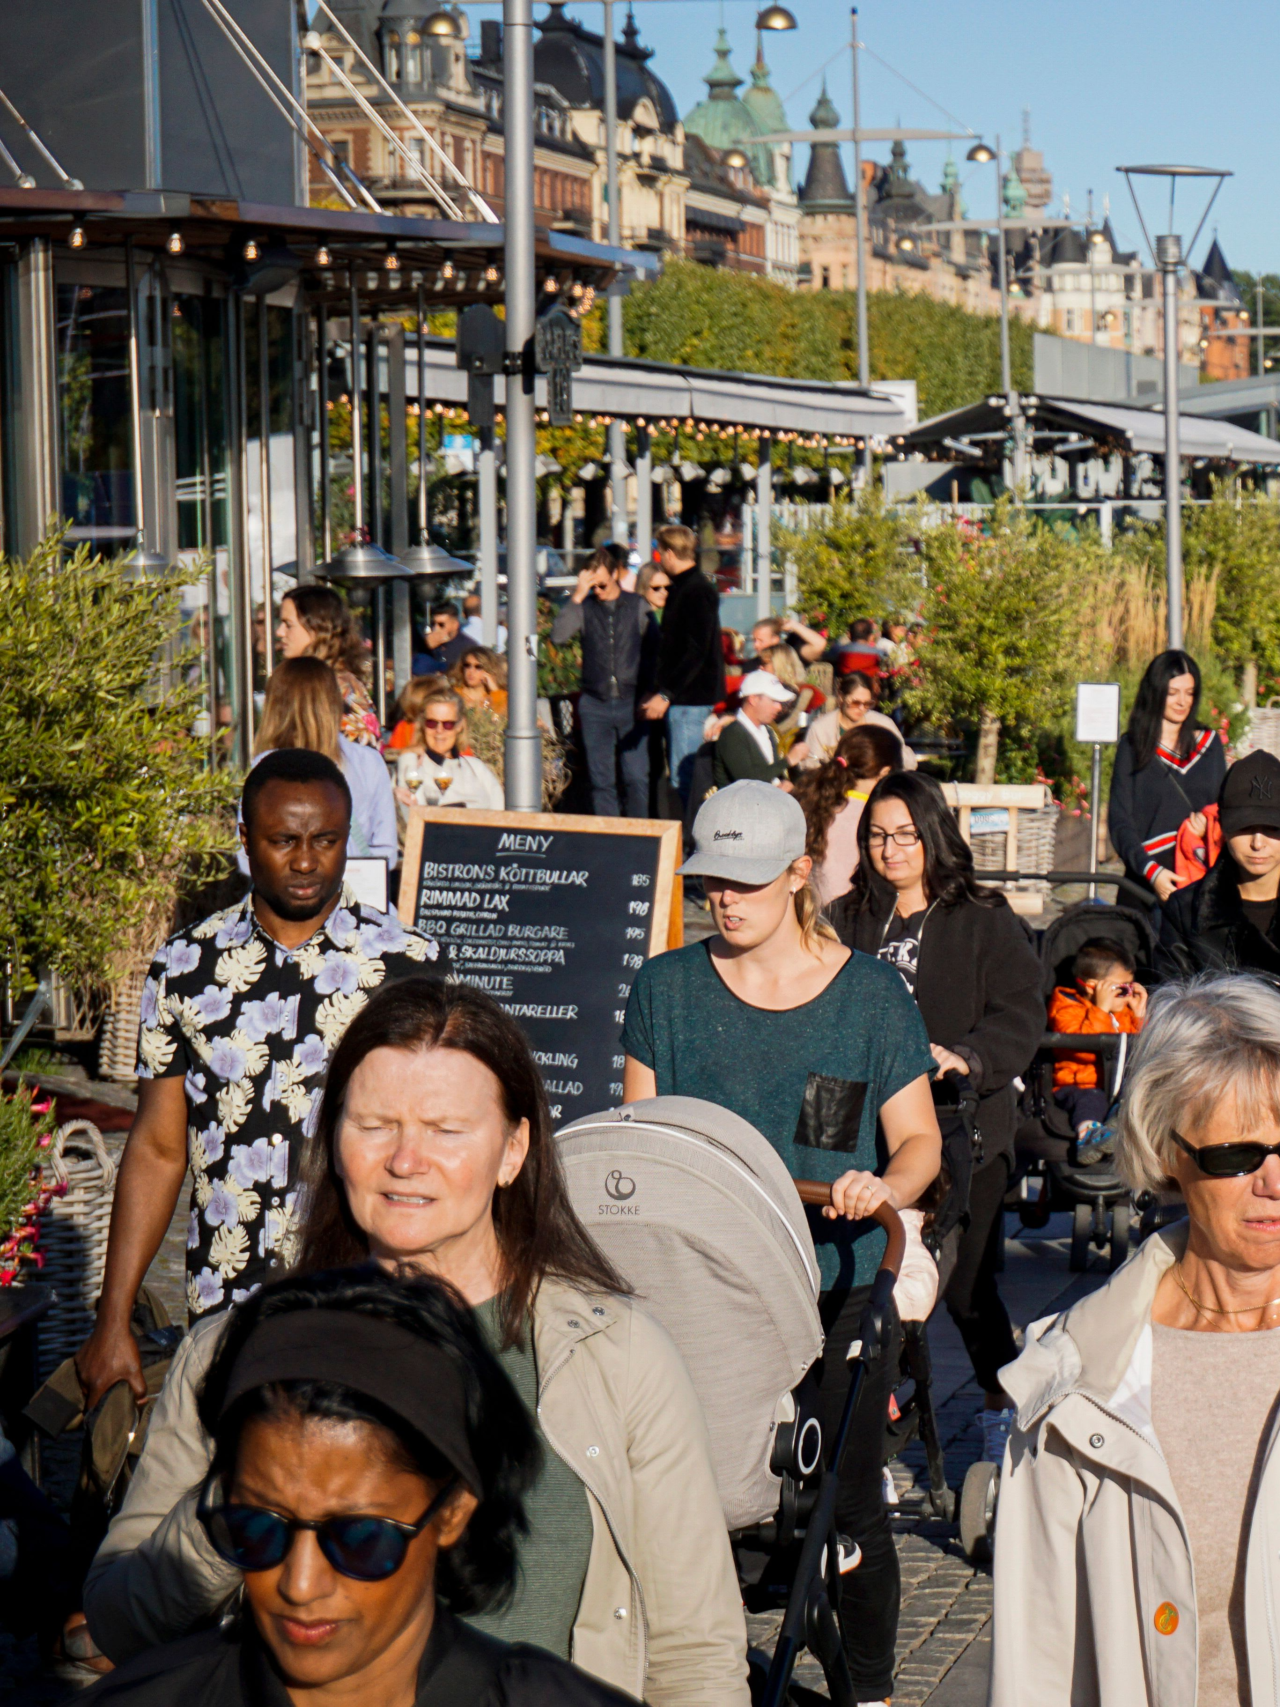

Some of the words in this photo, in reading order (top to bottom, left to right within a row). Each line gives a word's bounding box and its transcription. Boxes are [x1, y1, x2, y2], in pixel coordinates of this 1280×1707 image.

[497, 832, 554, 852] MENY
[713, 829, 743, 842] Brooklyn
[423, 861, 496, 880] BISTRONS
[499, 863, 589, 887] KÖTTBULLAR
[631, 873, 651, 887] 185
[420, 888, 481, 908] RIMMAD
[483, 893, 510, 912] LAX
[628, 900, 650, 916] 198
[418, 918, 447, 935] BBQ
[450, 922, 505, 938] GRILLAD
[508, 923, 569, 939] BURGARE
[625, 927, 646, 940] 195
[448, 944, 458, 960] &
[459, 945, 566, 965] SKALDJURSSOPPA
[623, 953, 644, 970] 198
[459, 973, 514, 990] MINUTE
[500, 1003, 579, 1019] NTARELLER
[544, 1080, 584, 1095] ALLAD
[598, 1204, 641, 1216] STOKKE
